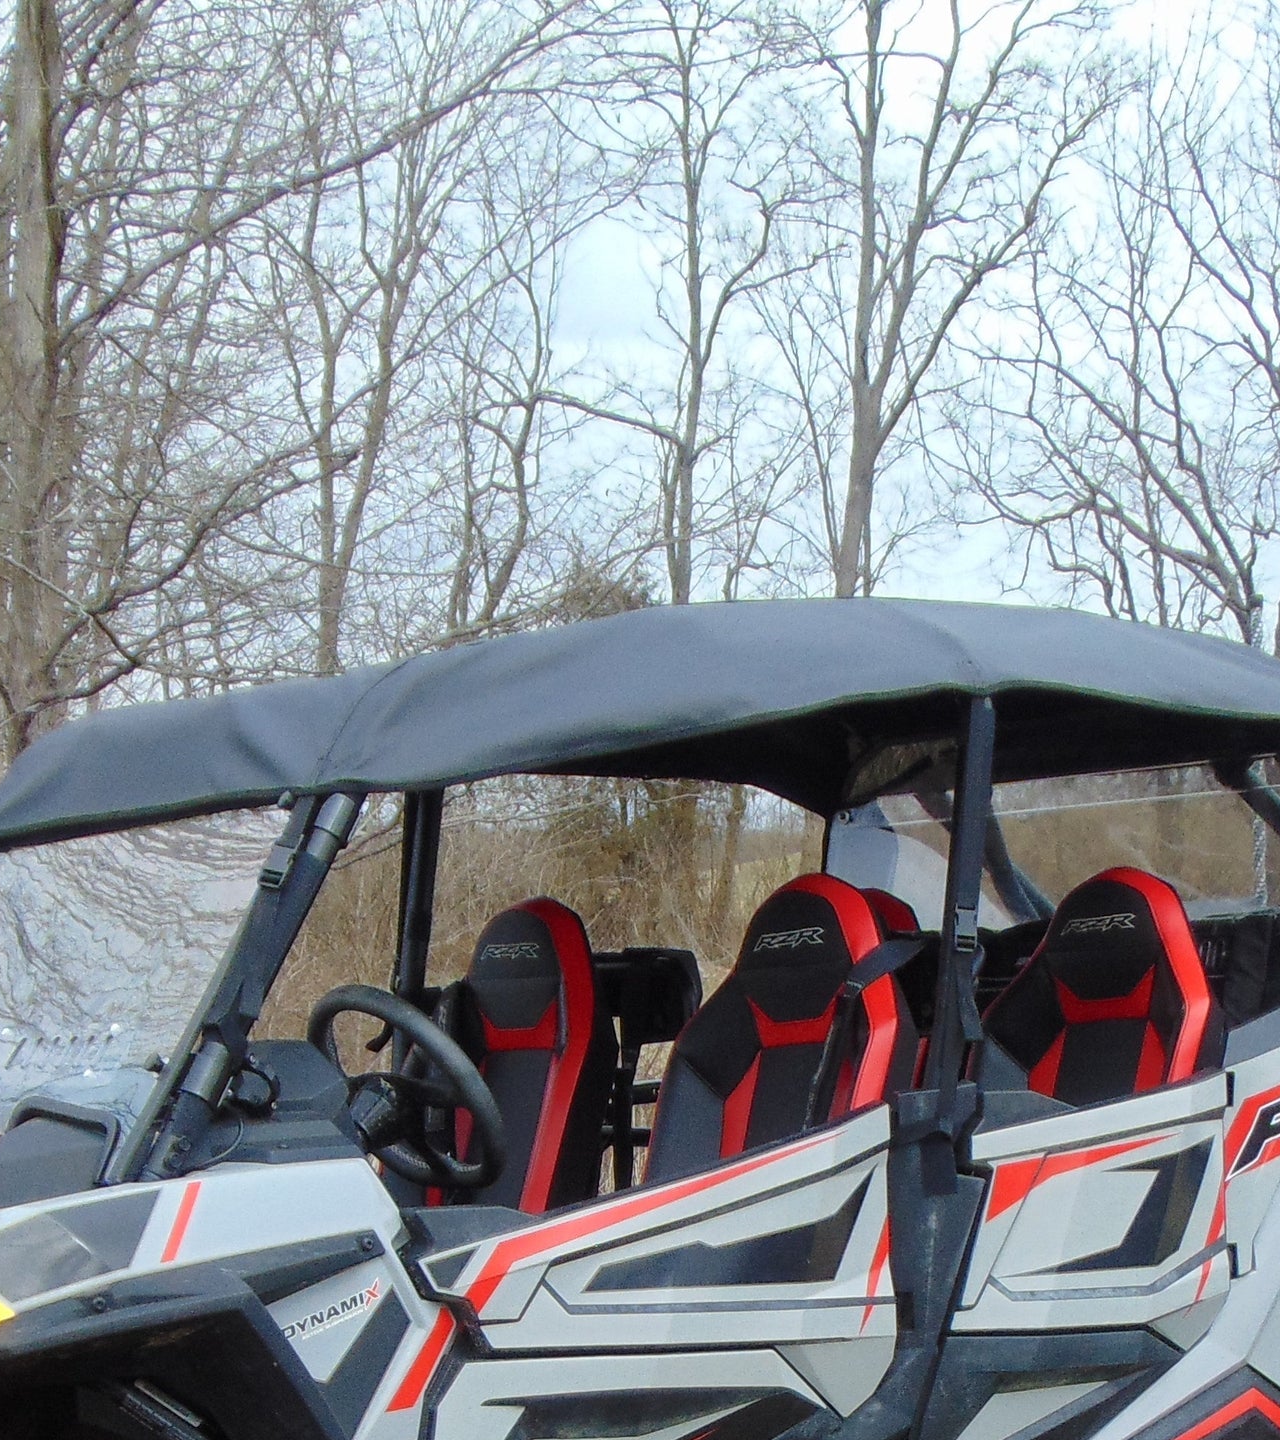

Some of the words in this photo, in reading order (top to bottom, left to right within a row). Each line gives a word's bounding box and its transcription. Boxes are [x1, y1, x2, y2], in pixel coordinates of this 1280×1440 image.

[1060, 912, 1137, 936] RZR
[480, 942, 540, 961] RZR
[753, 926, 825, 952] RZR
[280, 1277, 381, 1340] DYNAMIX
